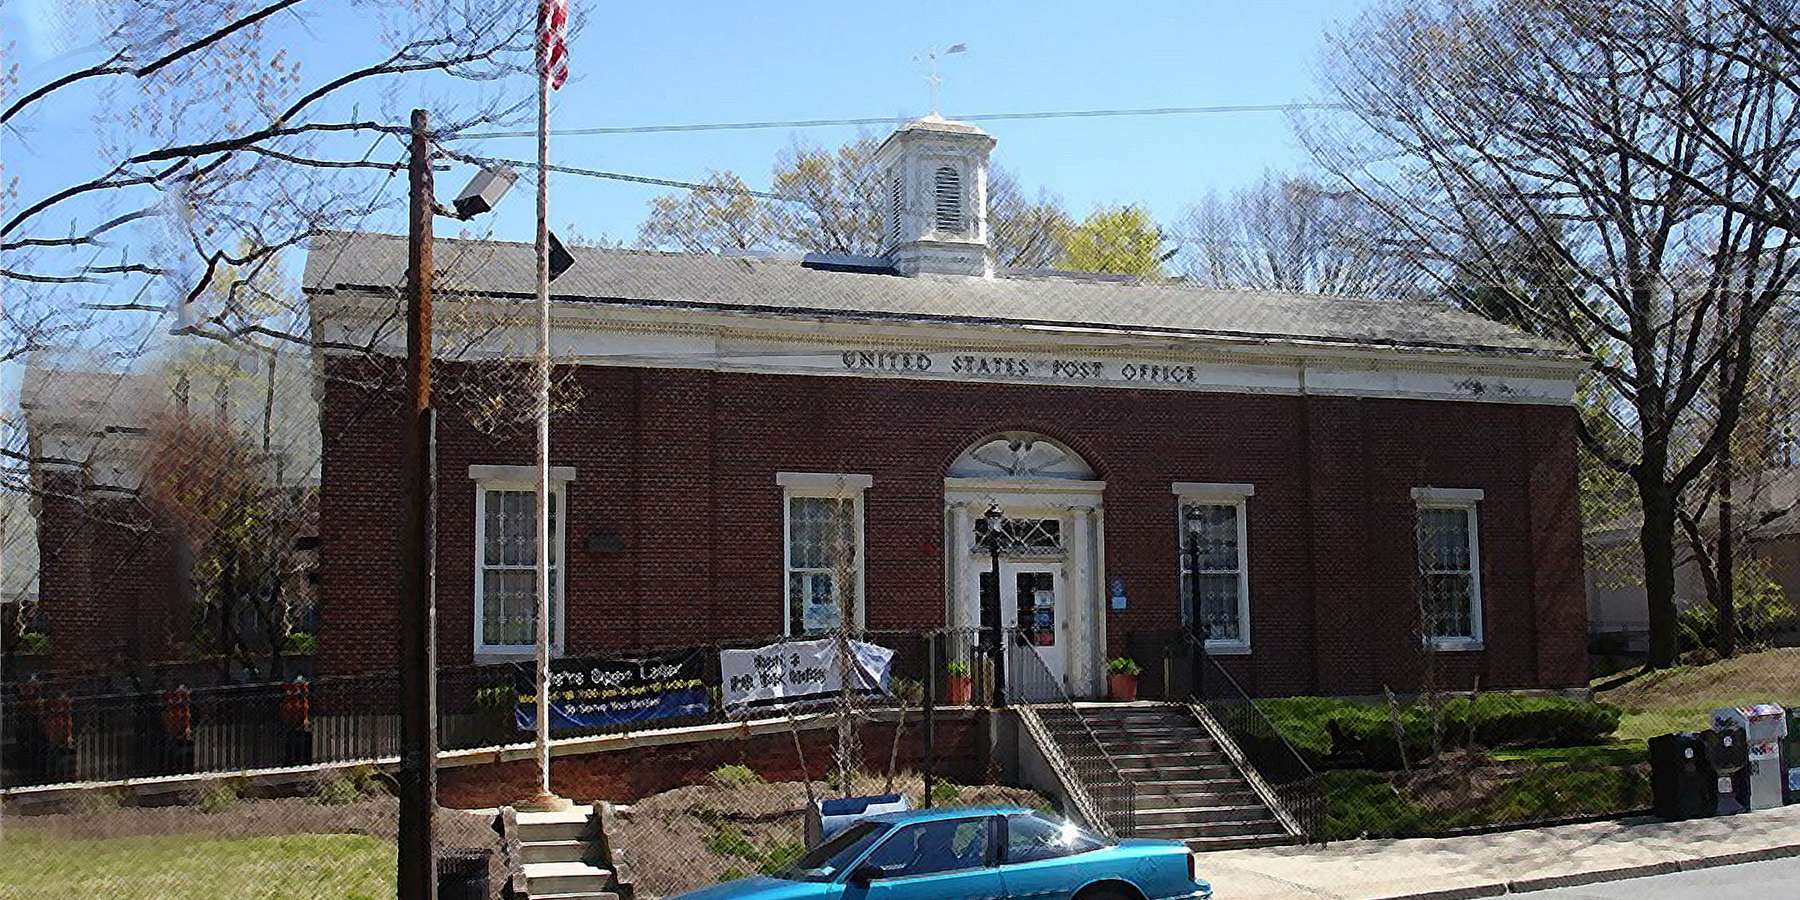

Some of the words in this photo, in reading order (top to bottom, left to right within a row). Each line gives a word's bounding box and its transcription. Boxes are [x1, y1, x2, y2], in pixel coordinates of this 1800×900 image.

[842, 352, 932, 370] UNITED
[951, 355, 1029, 376] STATES
[1053, 359, 1103, 378] POST
[1121, 363, 1197, 383] OFFICE
[547, 670, 584, 687] e're
[591, 667, 633, 687] Open
[639, 661, 684, 681] Later
[610, 699, 629, 711] You
[631, 697, 661, 710] Better
